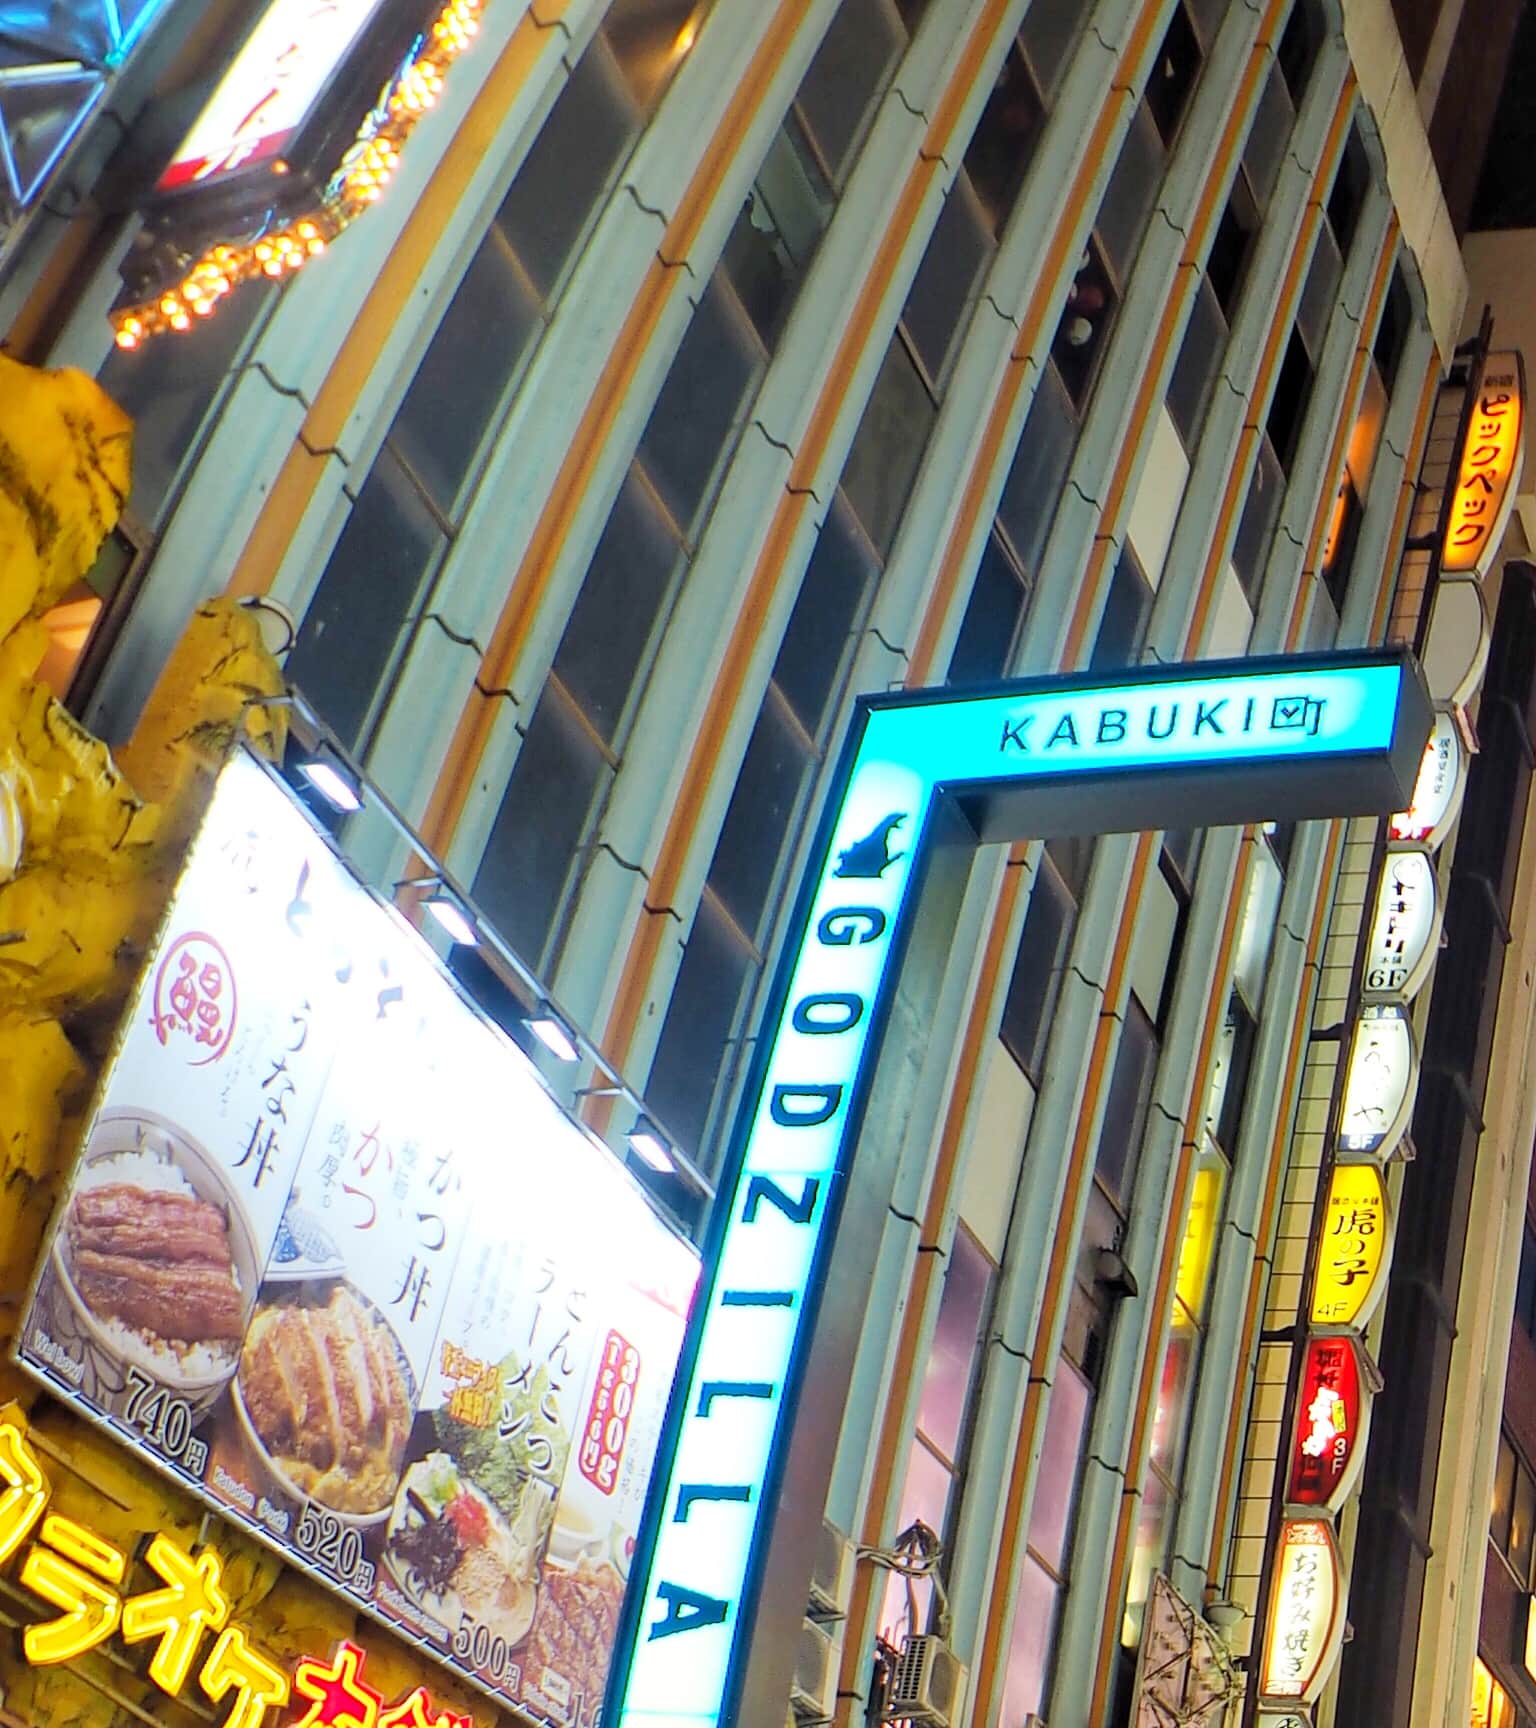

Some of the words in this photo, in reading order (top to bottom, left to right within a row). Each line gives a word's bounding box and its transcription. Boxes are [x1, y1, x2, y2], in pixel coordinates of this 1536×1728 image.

[1367, 967, 1408, 991] 6F
[232, 1000, 312, 1190] うな丼
[389, 1149, 462, 1323] かつ丼
[648, 906, 885, 1642] GODZILLA
[1331, 1208, 1378, 1287] 虎の子
[1317, 1302, 1349, 1318] 4F
[124, 1369, 208, 1475] 740円
[299, 1503, 375, 1596] 520円
[454, 1608, 521, 1694] 500円
